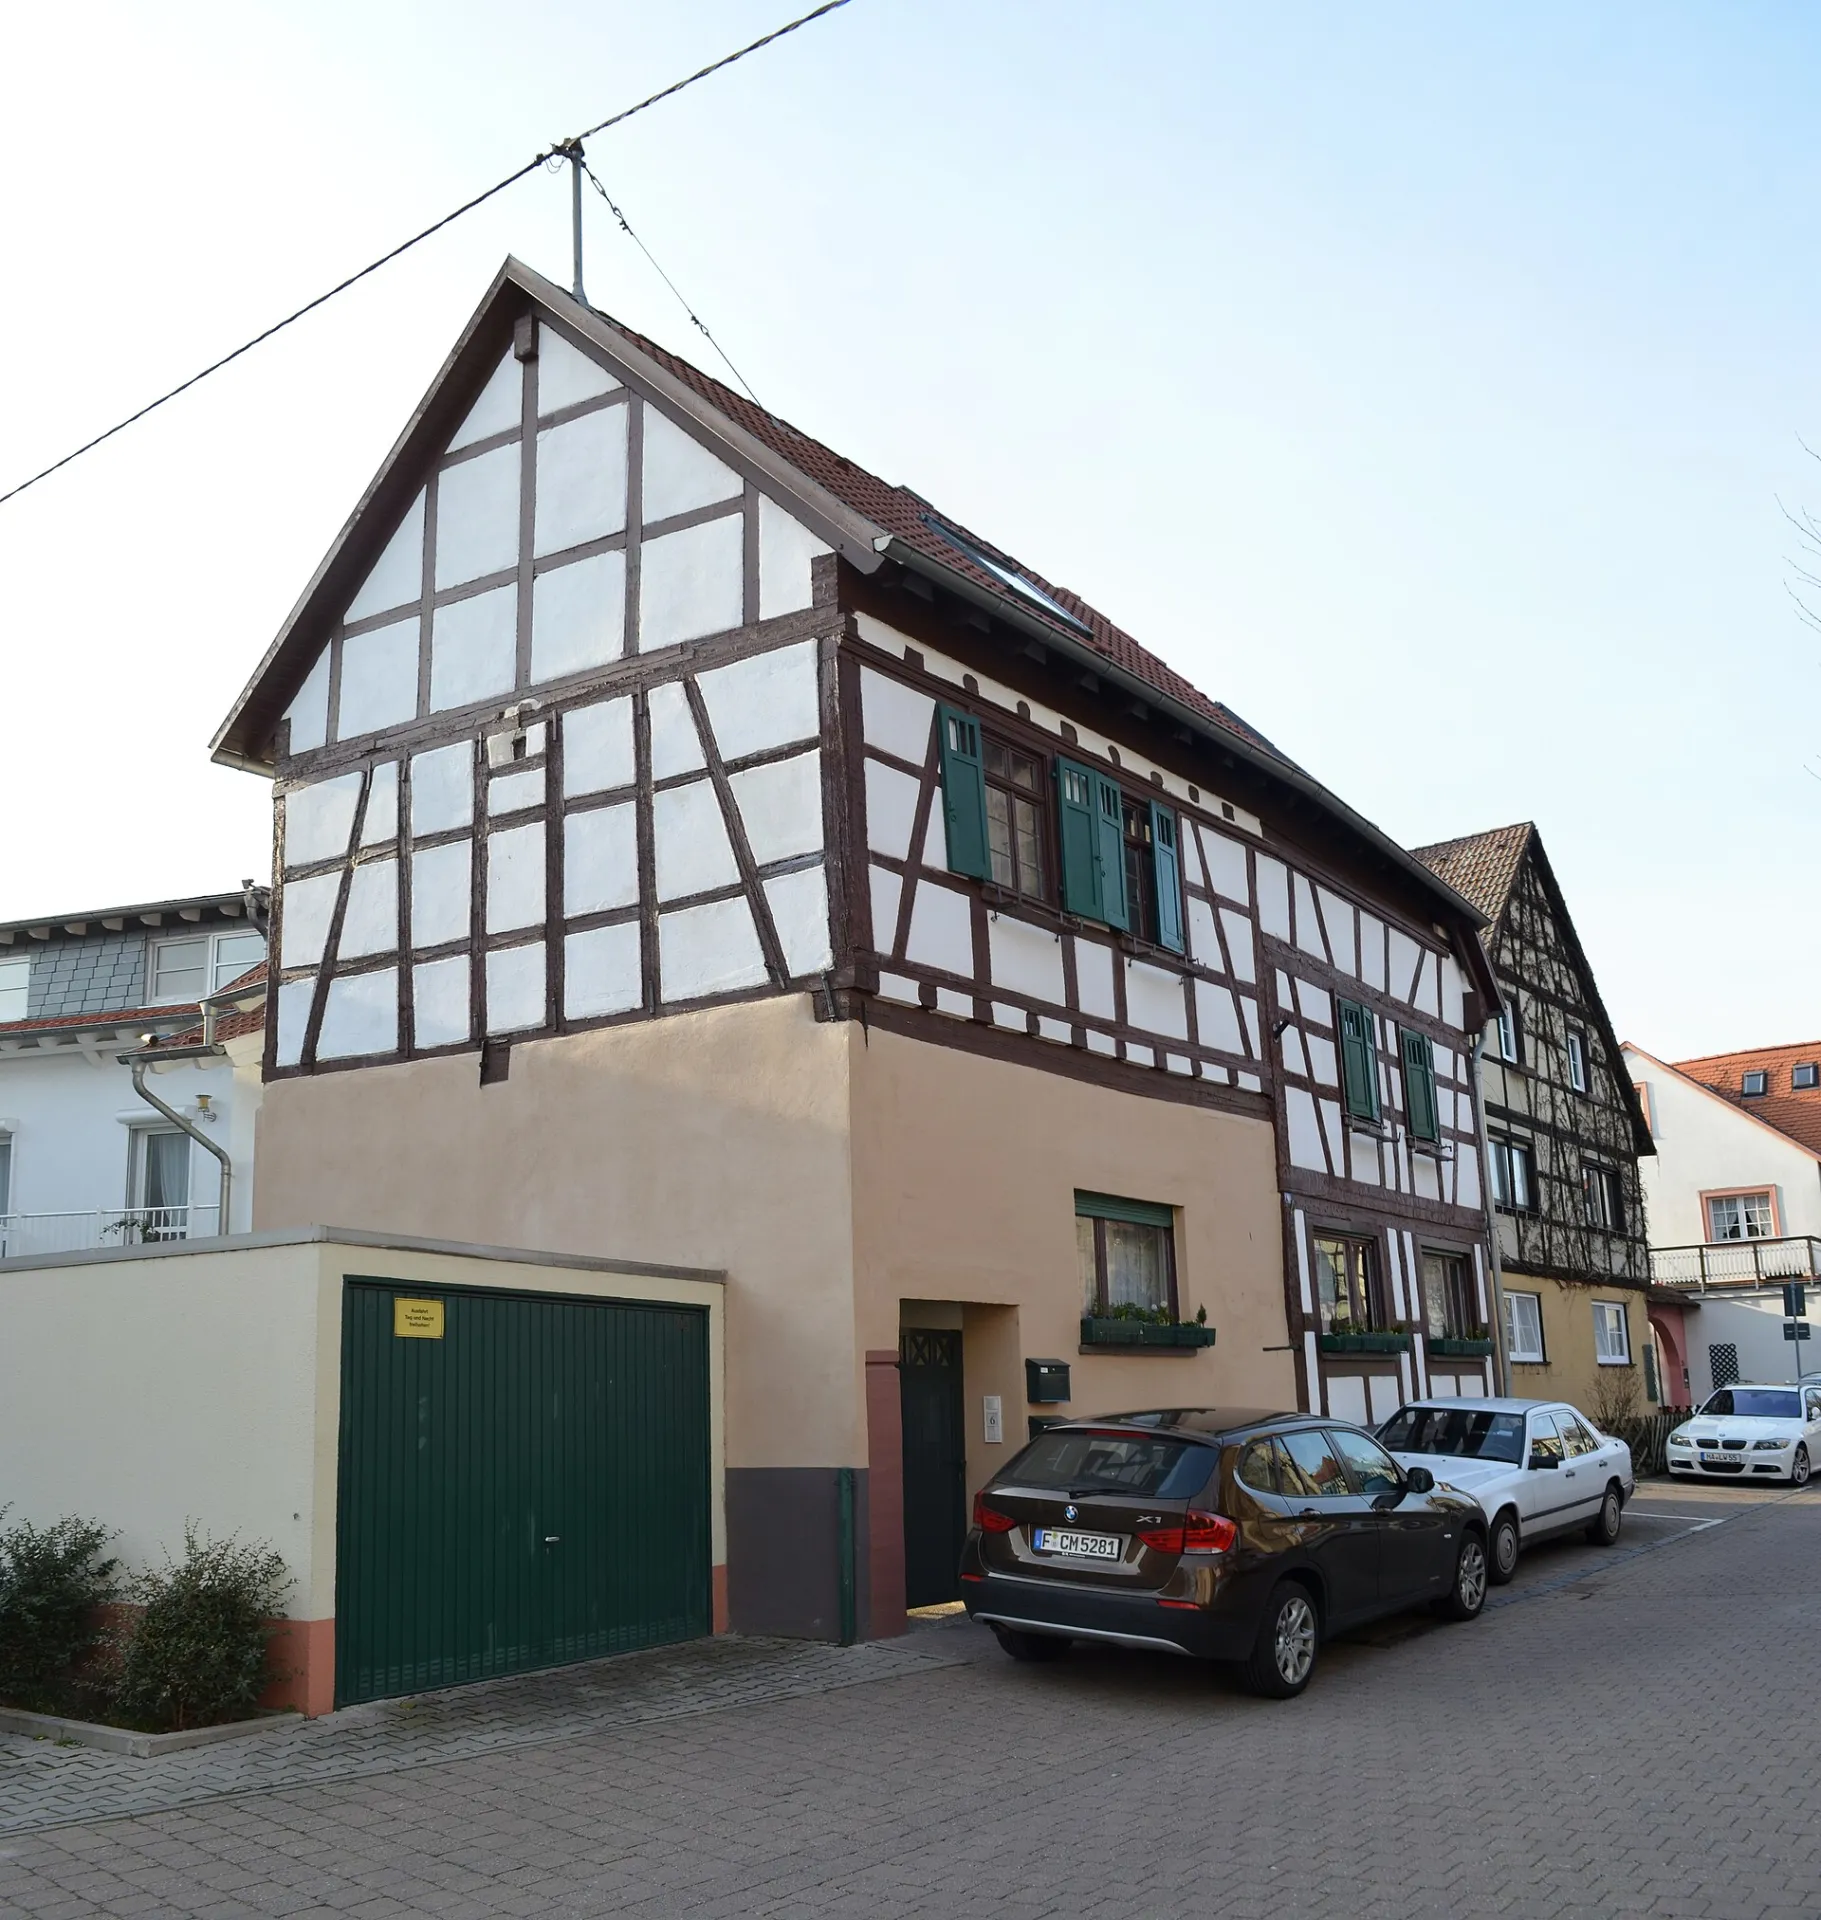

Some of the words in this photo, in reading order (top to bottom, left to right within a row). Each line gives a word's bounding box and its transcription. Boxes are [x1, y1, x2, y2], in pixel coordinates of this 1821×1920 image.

[989, 1415, 996, 1425] 6
[1135, 1515, 1162, 1524] X1
[1042, 1533, 1052, 1548] F
